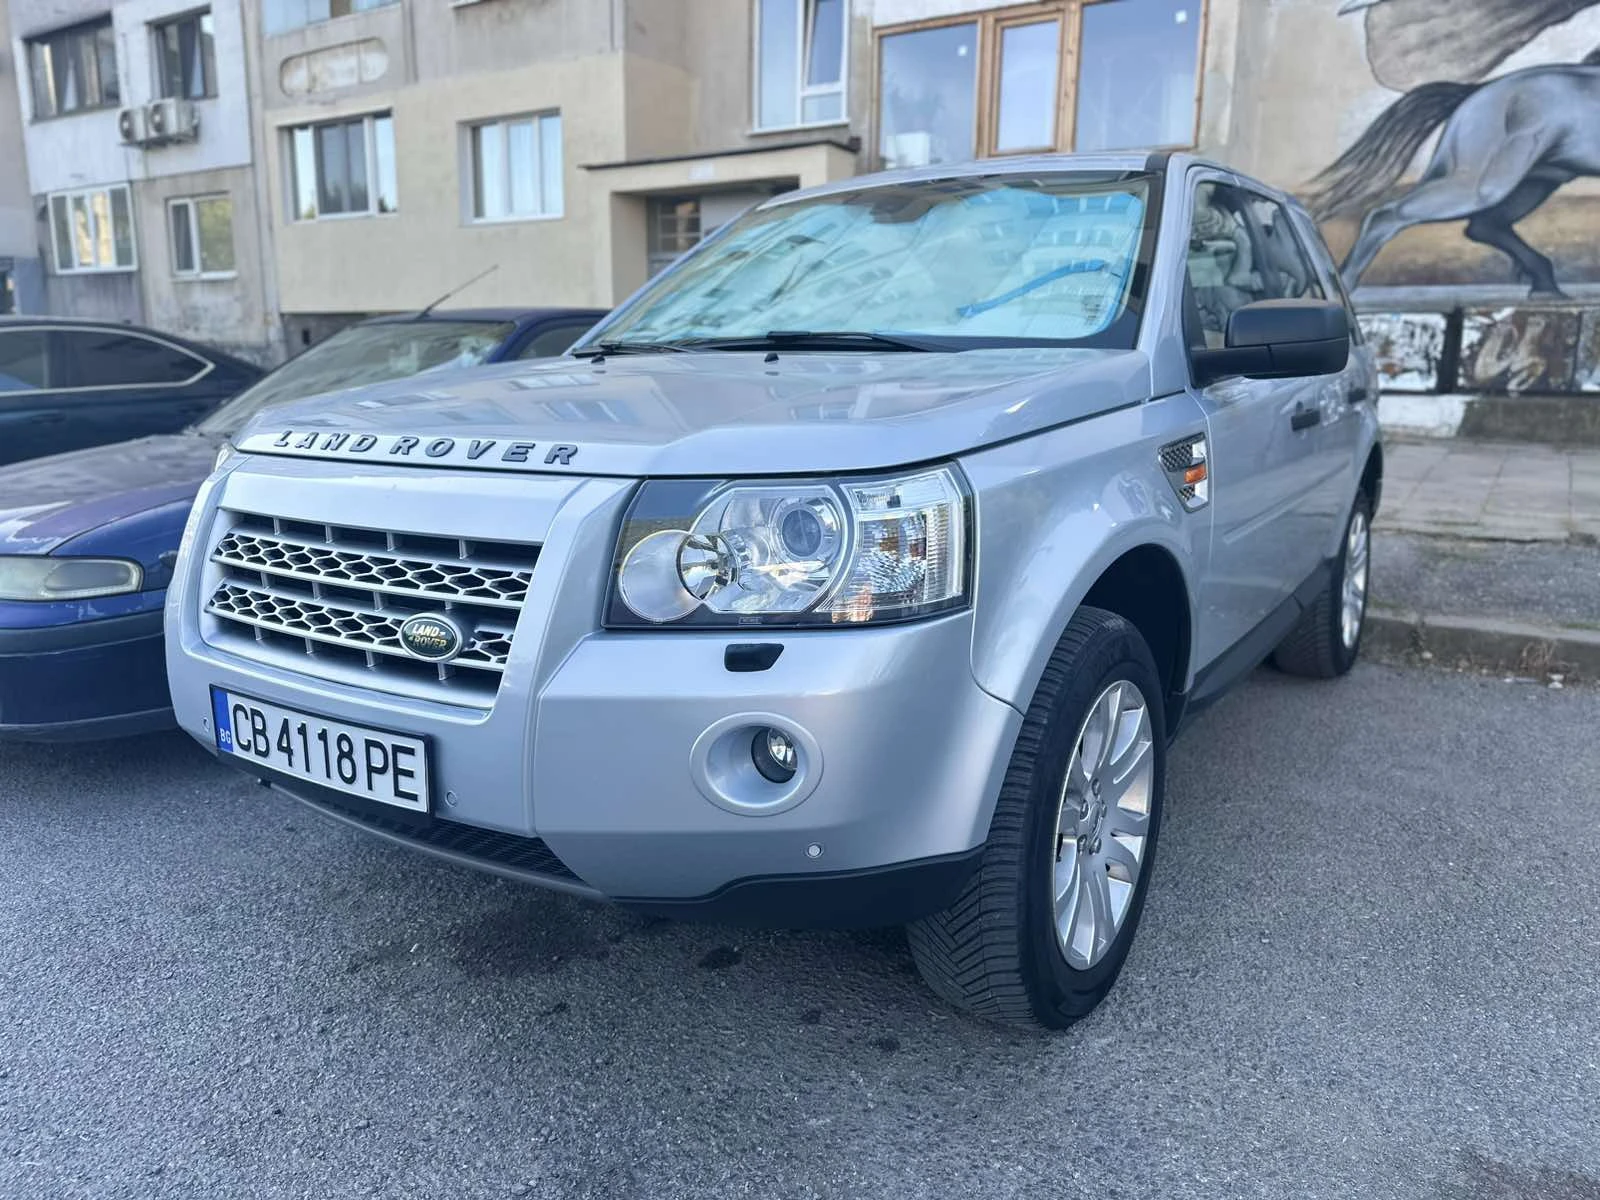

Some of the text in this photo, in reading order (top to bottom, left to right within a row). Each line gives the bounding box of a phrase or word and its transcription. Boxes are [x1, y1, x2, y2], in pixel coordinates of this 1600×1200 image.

[273, 430, 578, 465] LAND ROVER
[220, 727, 231, 744] BG
